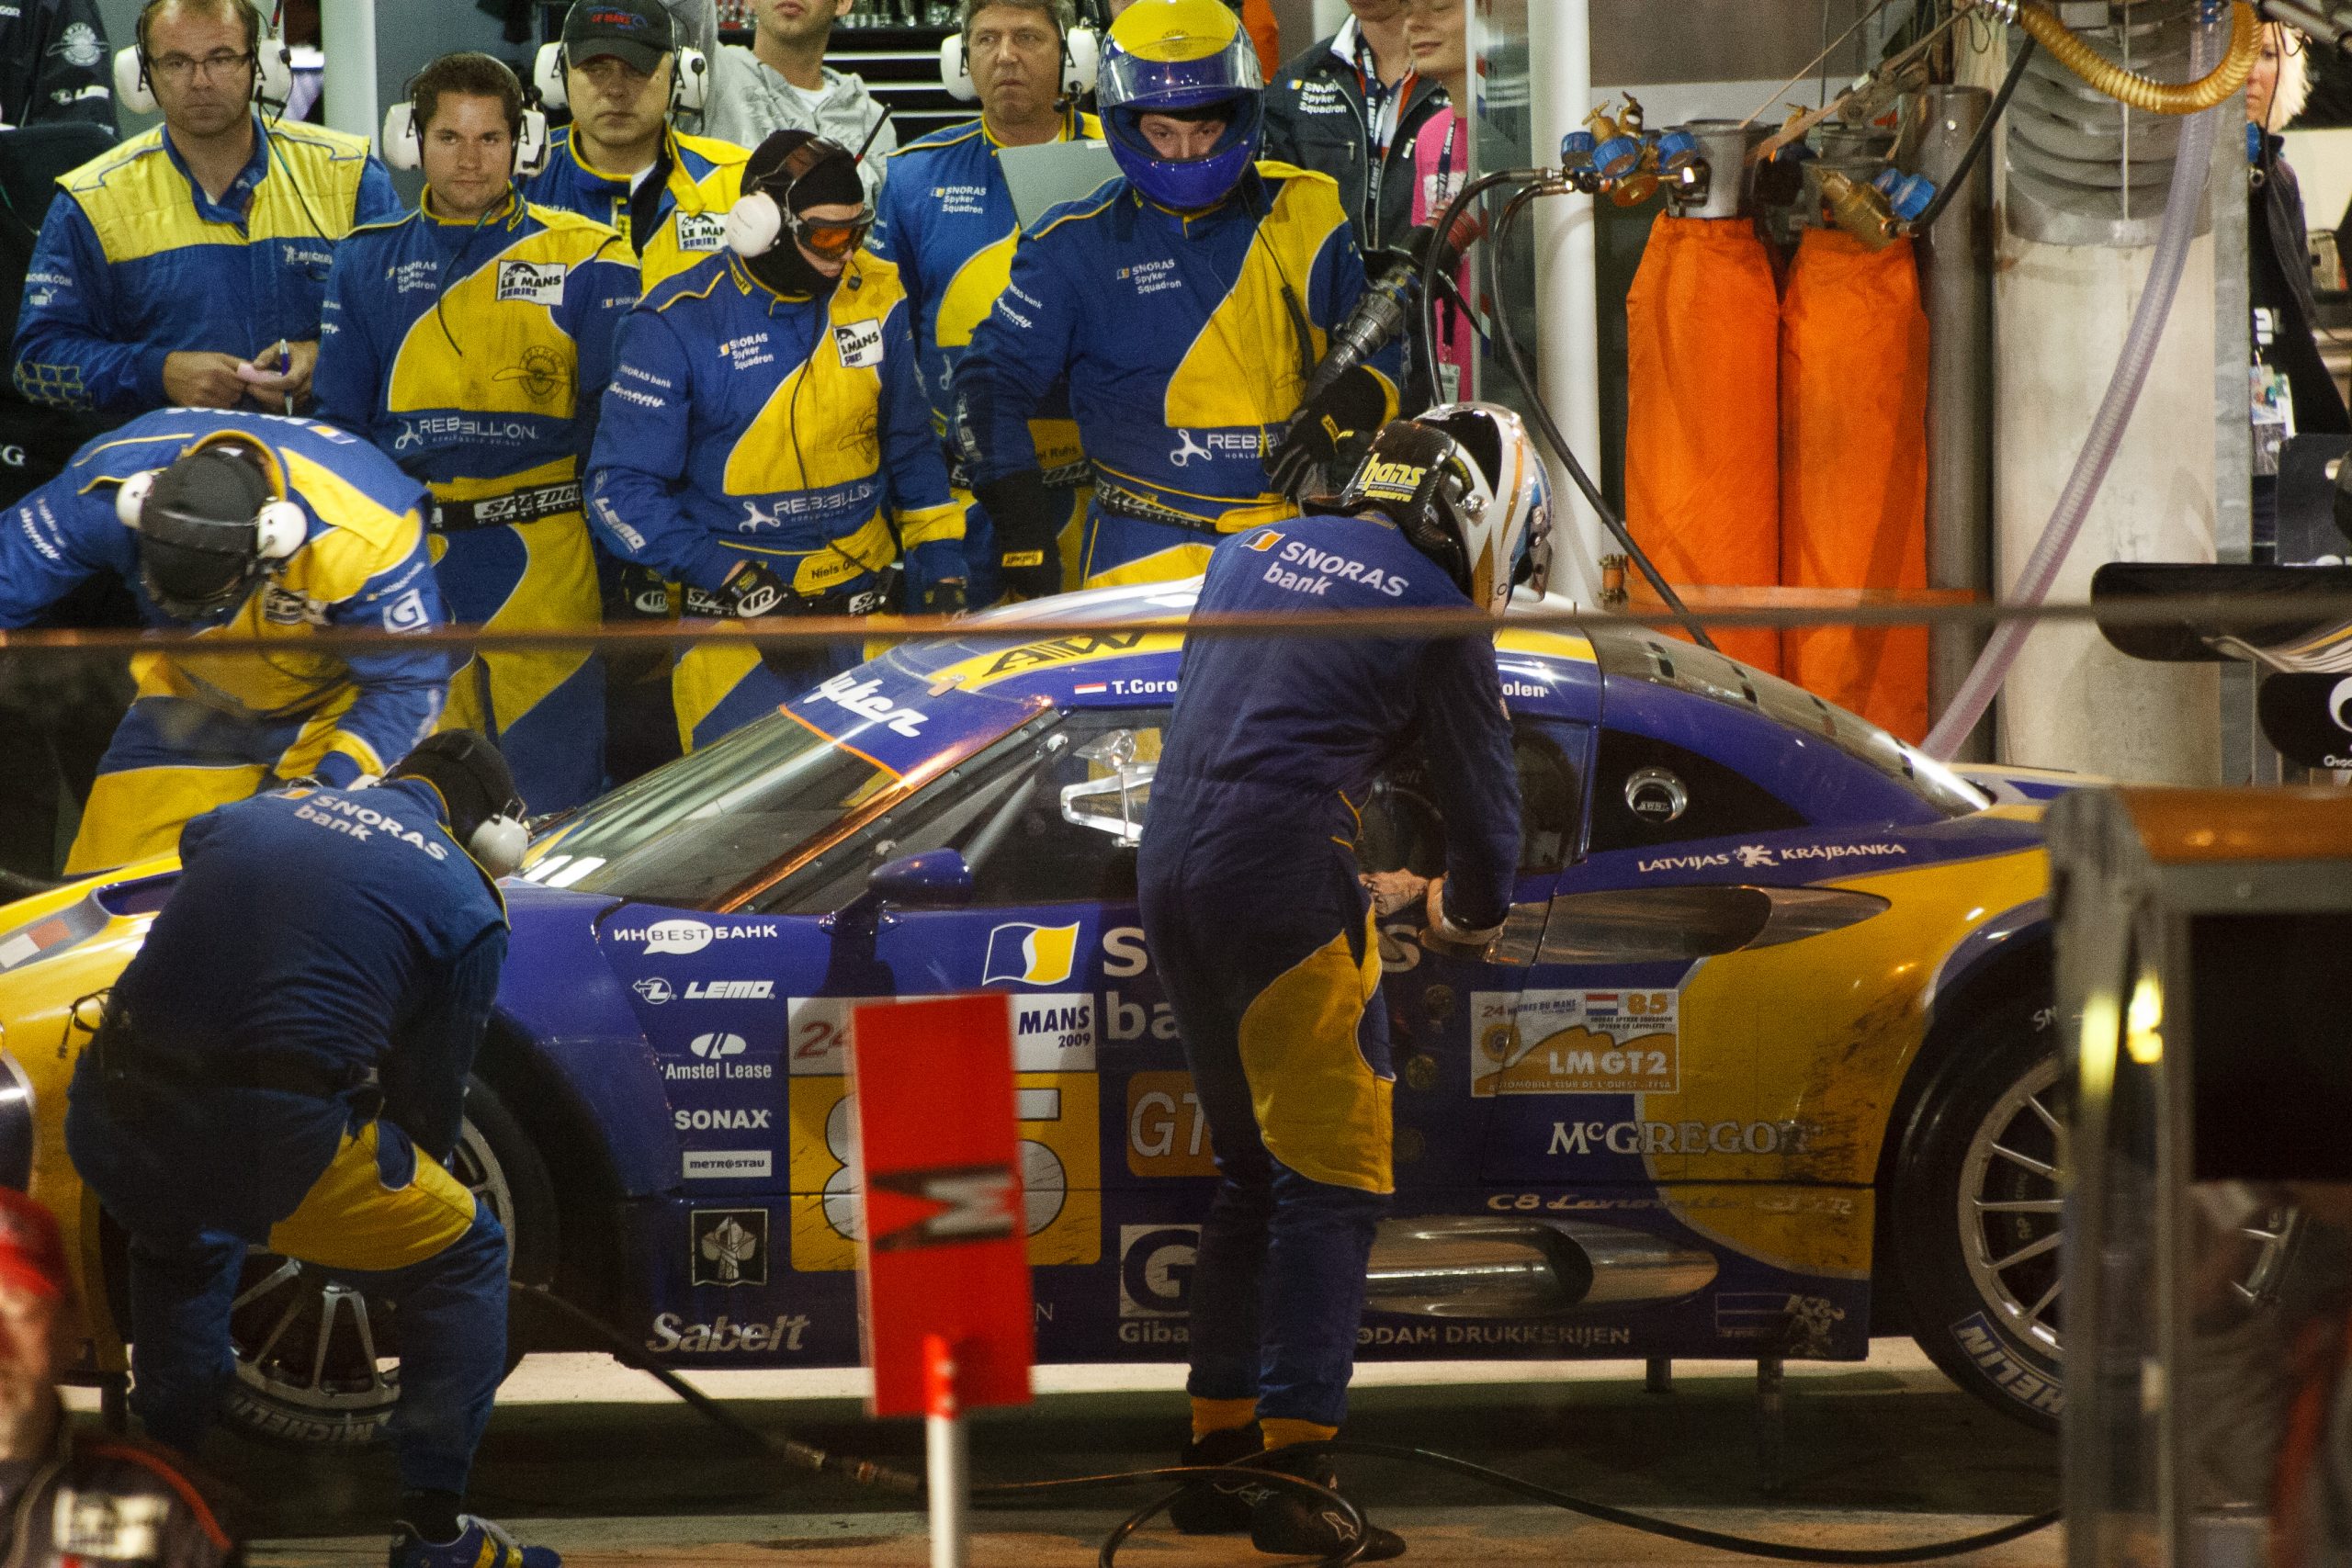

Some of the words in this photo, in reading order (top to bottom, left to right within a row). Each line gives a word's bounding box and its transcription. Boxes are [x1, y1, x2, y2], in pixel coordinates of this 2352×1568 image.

[1302, 92, 1336, 104] Spyker
[1299, 102, 1347, 115] Squadron
[945, 186, 987, 197] SNORAS
[942, 204, 983, 214] Squadron
[944, 196, 975, 205] Spyker
[682, 229, 695, 239] LE
[1132, 258, 1175, 276] SNORAS
[501, 276, 514, 289] LE
[520, 276, 561, 288] MANS
[1135, 272, 1167, 285] Spyker
[500, 288, 537, 299] SERIES
[1137, 280, 1182, 295] Squadron
[650, 373, 673, 389] bank
[1361, 452, 1427, 491] hans
[1279, 540, 1409, 598] SNORAS
[1262, 561, 1333, 596] bank
[1111, 679, 1177, 695] T.Coro
[1502, 681, 1546, 698] olen
[294, 805, 373, 842] bank
[311, 795, 449, 862] SNORAS
[1638, 854, 1730, 873] LATVIJAS
[1781, 844, 1907, 862] KRĀJBANKA
[684, 981, 775, 999] LEMO
[1481, 1005, 1505, 1018] 24
[1627, 992, 1668, 1015] 85
[1018, 1006, 1091, 1035] MANS
[1105, 990, 1182, 1041] ba
[1057, 1032, 1091, 1049] 2009
[664, 1063, 720, 1080] Amstel
[725, 1064, 772, 1079] Lease
[674, 1109, 770, 1131] SONAX
[1130, 1091, 1206, 1158] GT
[646, 1312, 811, 1353] Sabelt
[1118, 1321, 1191, 1344] Giba
[1958, 1325, 2066, 1416] HELIN
